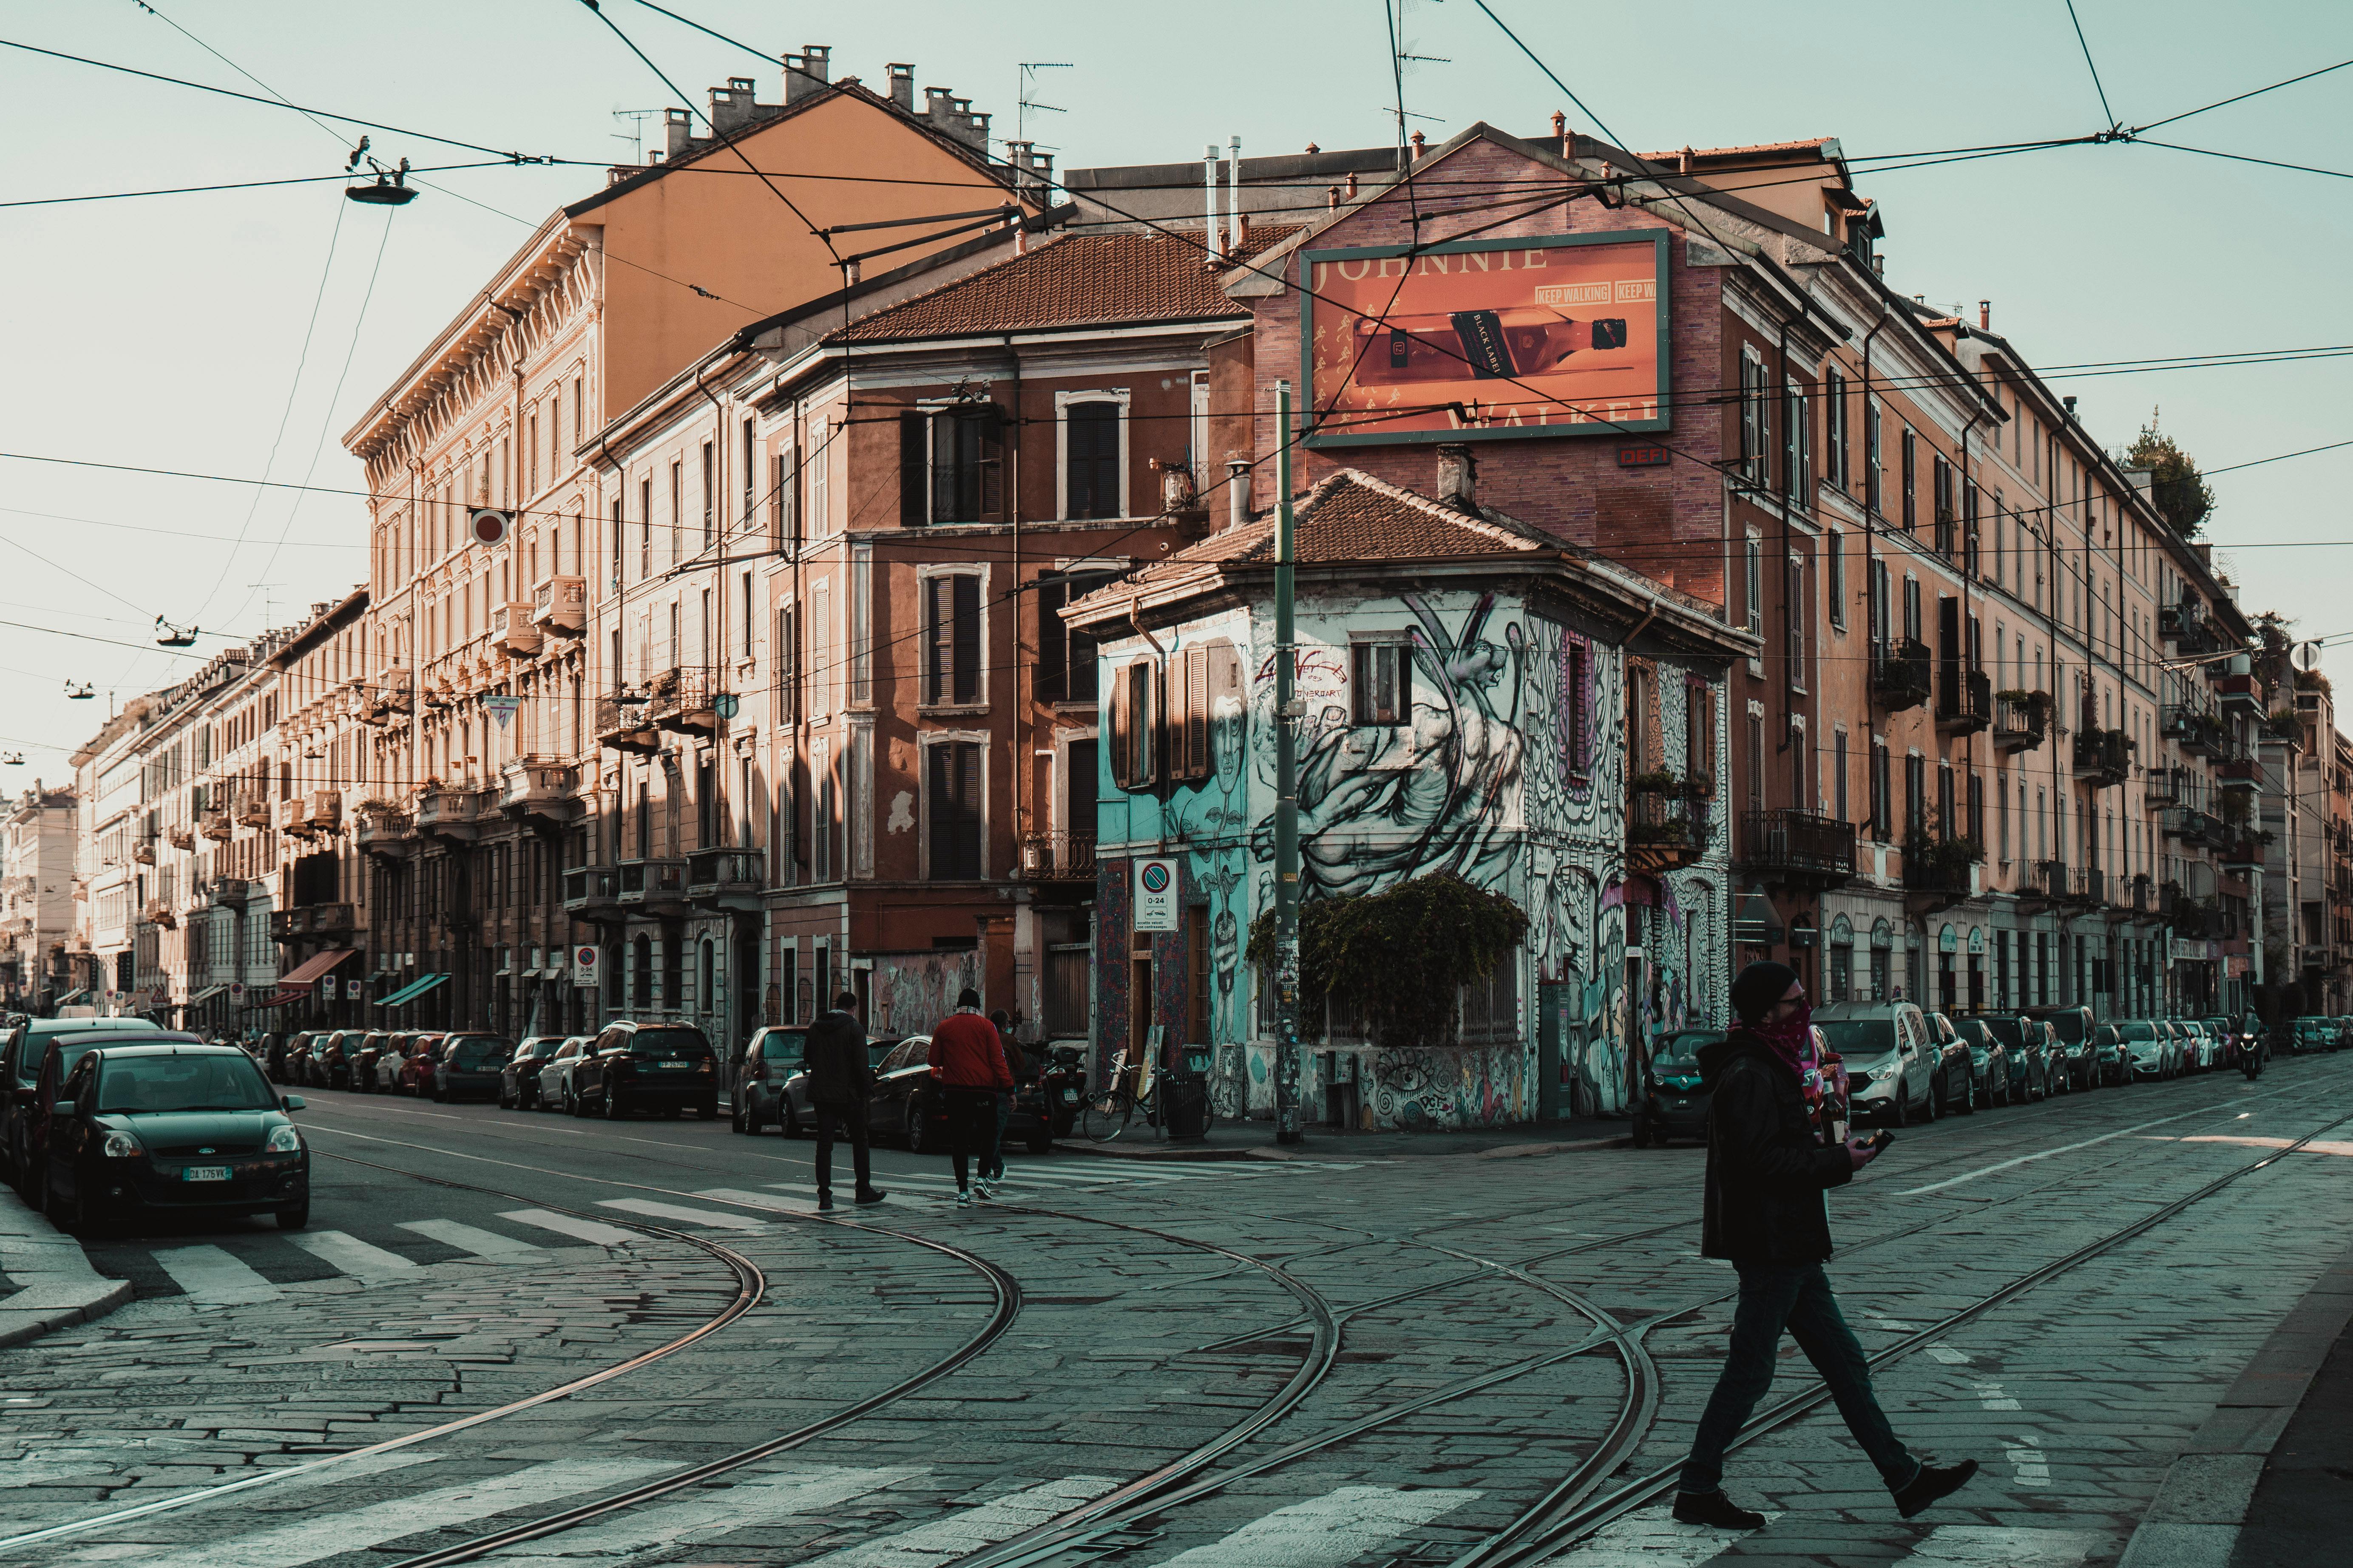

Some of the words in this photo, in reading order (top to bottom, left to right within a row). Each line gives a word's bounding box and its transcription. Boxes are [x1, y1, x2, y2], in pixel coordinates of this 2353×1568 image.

[1539, 289, 1561, 304] KEEP
[1564, 286, 1607, 302] WALKING
[1619, 284, 1642, 299] KEEP
[1474, 315, 1490, 344] BLACK
[1621, 448, 1667, 463] DEFI
[190, 1169, 199, 1179] DA
